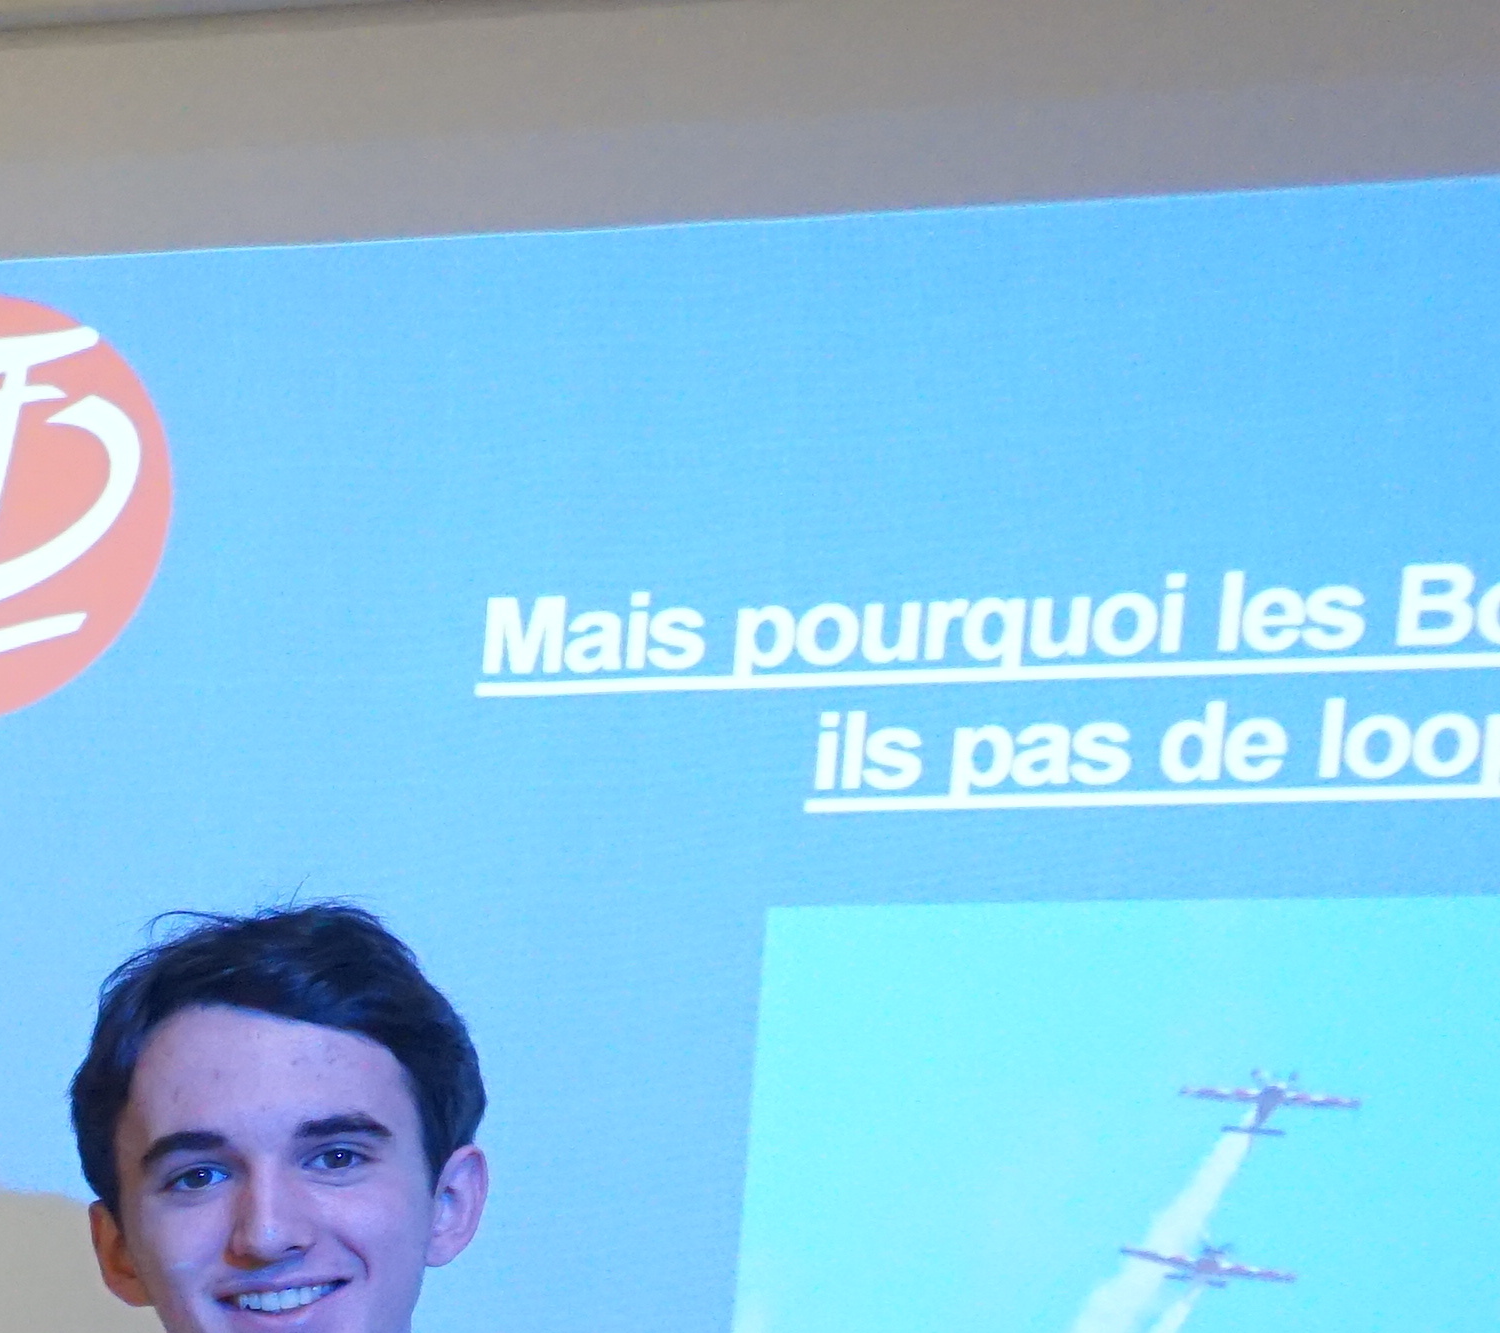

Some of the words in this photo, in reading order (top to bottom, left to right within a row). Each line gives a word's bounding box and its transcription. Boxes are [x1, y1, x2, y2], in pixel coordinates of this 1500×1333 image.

[481, 592, 706, 675] Mais
[732, 574, 1187, 680] pourquoi
[1215, 570, 1366, 653] les
[813, 710, 922, 791] ils
[949, 720, 1131, 798] pas
[1160, 700, 1287, 784] de
